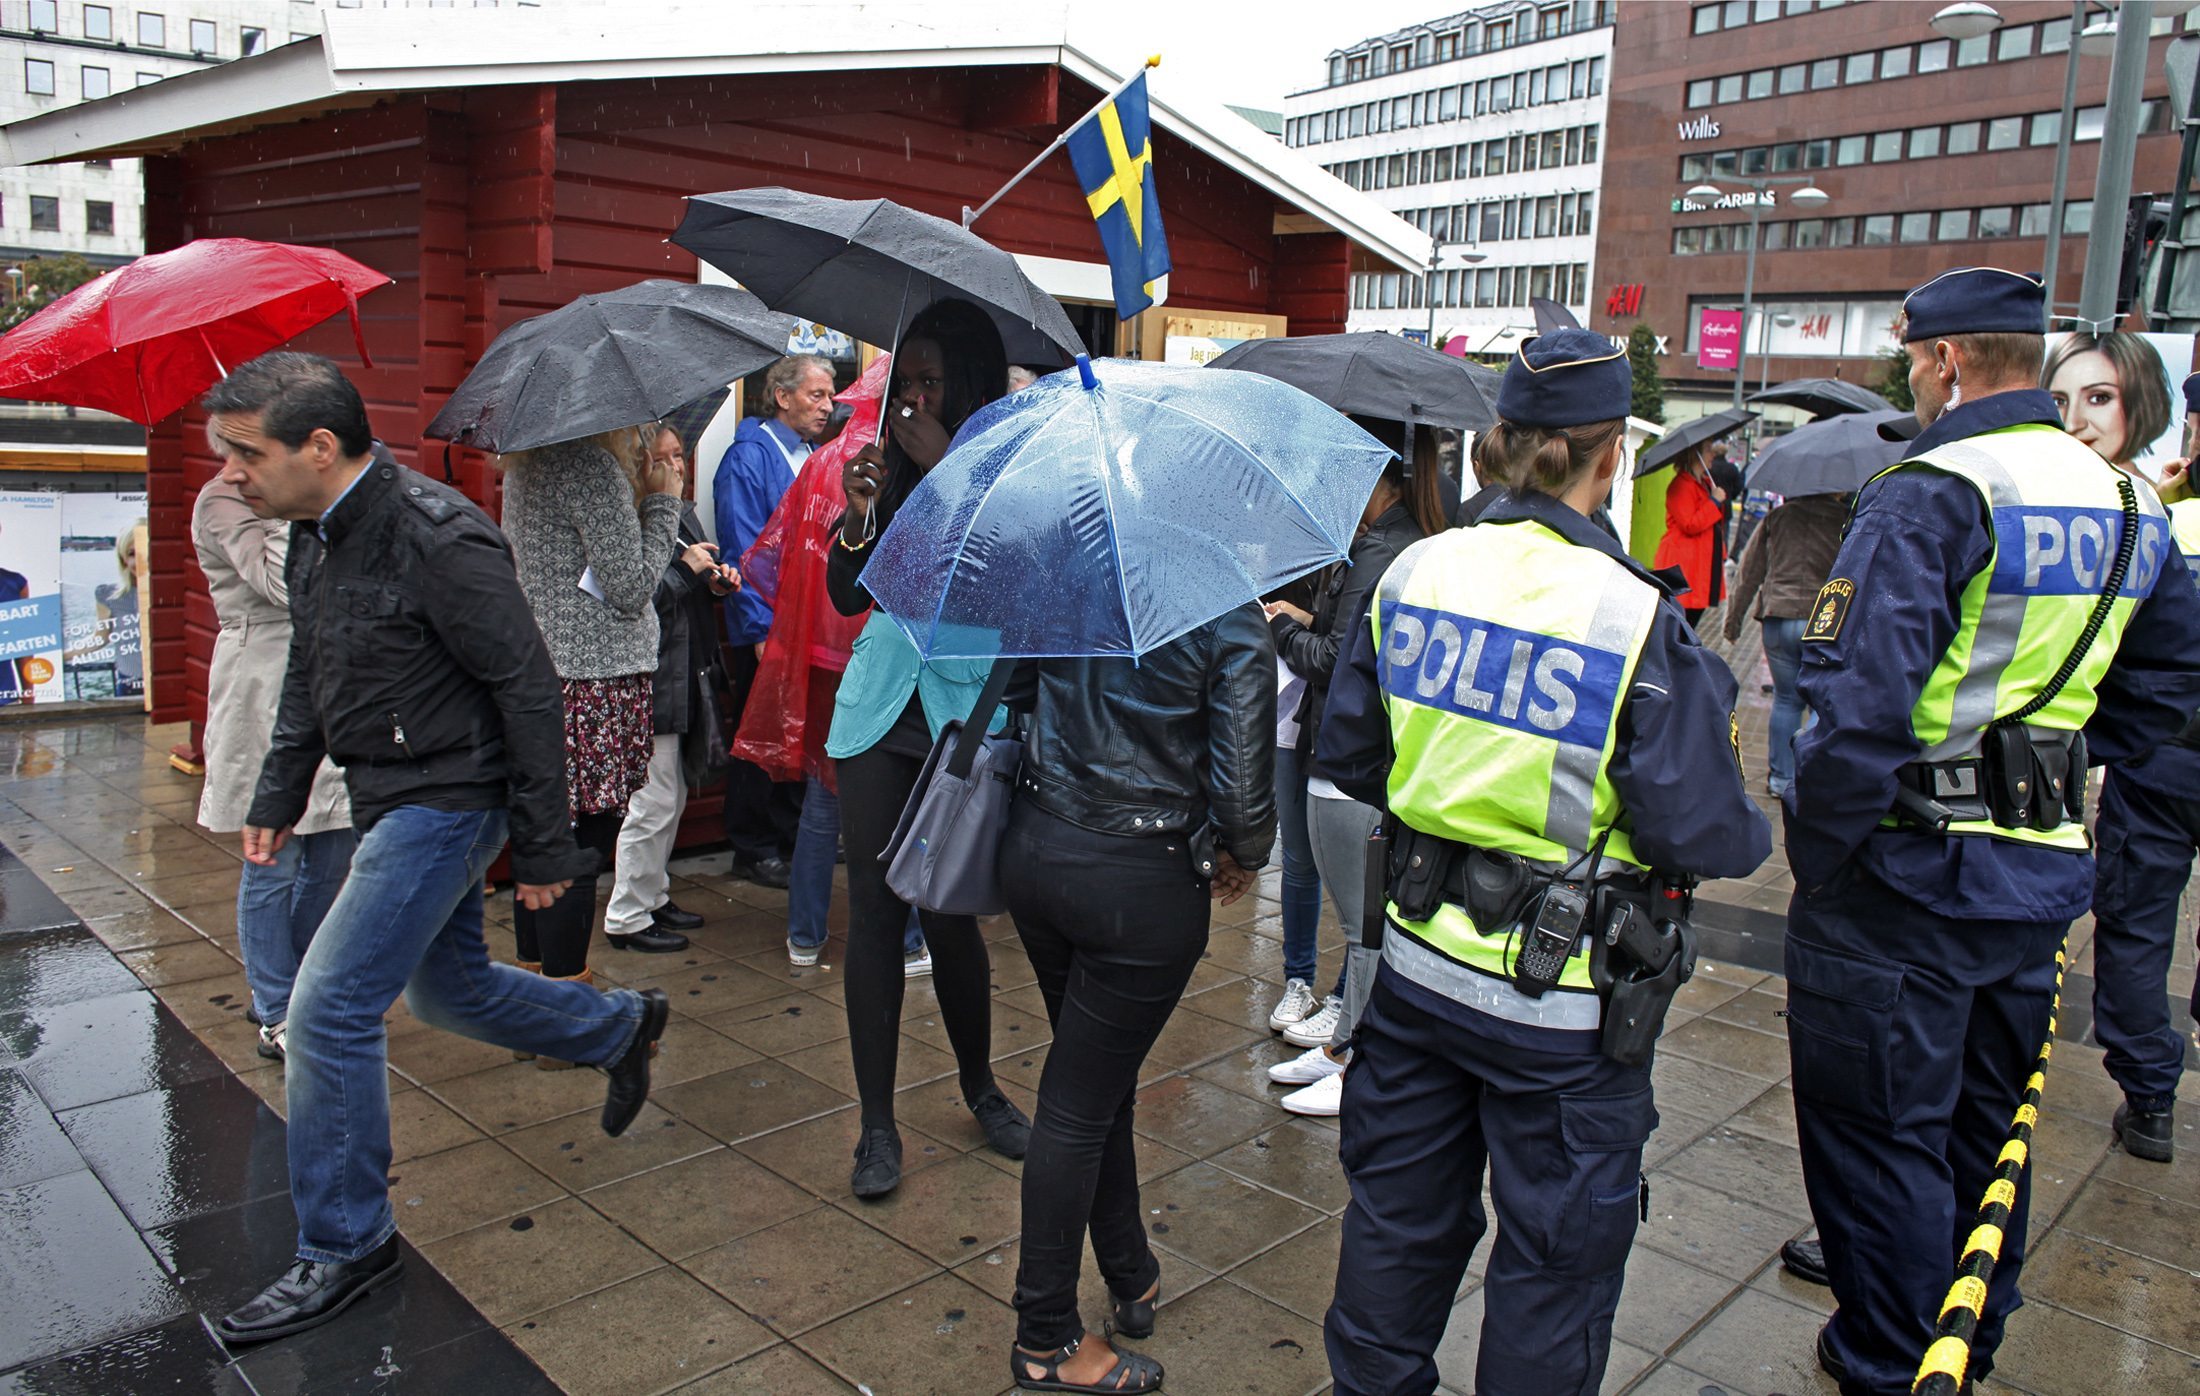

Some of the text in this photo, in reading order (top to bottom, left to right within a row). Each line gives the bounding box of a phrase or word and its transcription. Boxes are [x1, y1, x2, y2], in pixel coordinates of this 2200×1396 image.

[1678, 114, 1720, 140] Willis
[1605, 282, 1645, 318] H&M
[1800, 314, 1832, 340] H&M
[1190, 346, 1205, 364] Jag
[10, 495, 54, 503] HAMILTON
[2022, 515, 2160, 590] POLIS
[1823, 582, 1852, 599] POLIS
[96, 617, 118, 631] ETT
[67, 627, 140, 651] JOBB OCH
[71, 647, 116, 666] ALLTID
[1387, 612, 1585, 731] POLIS
